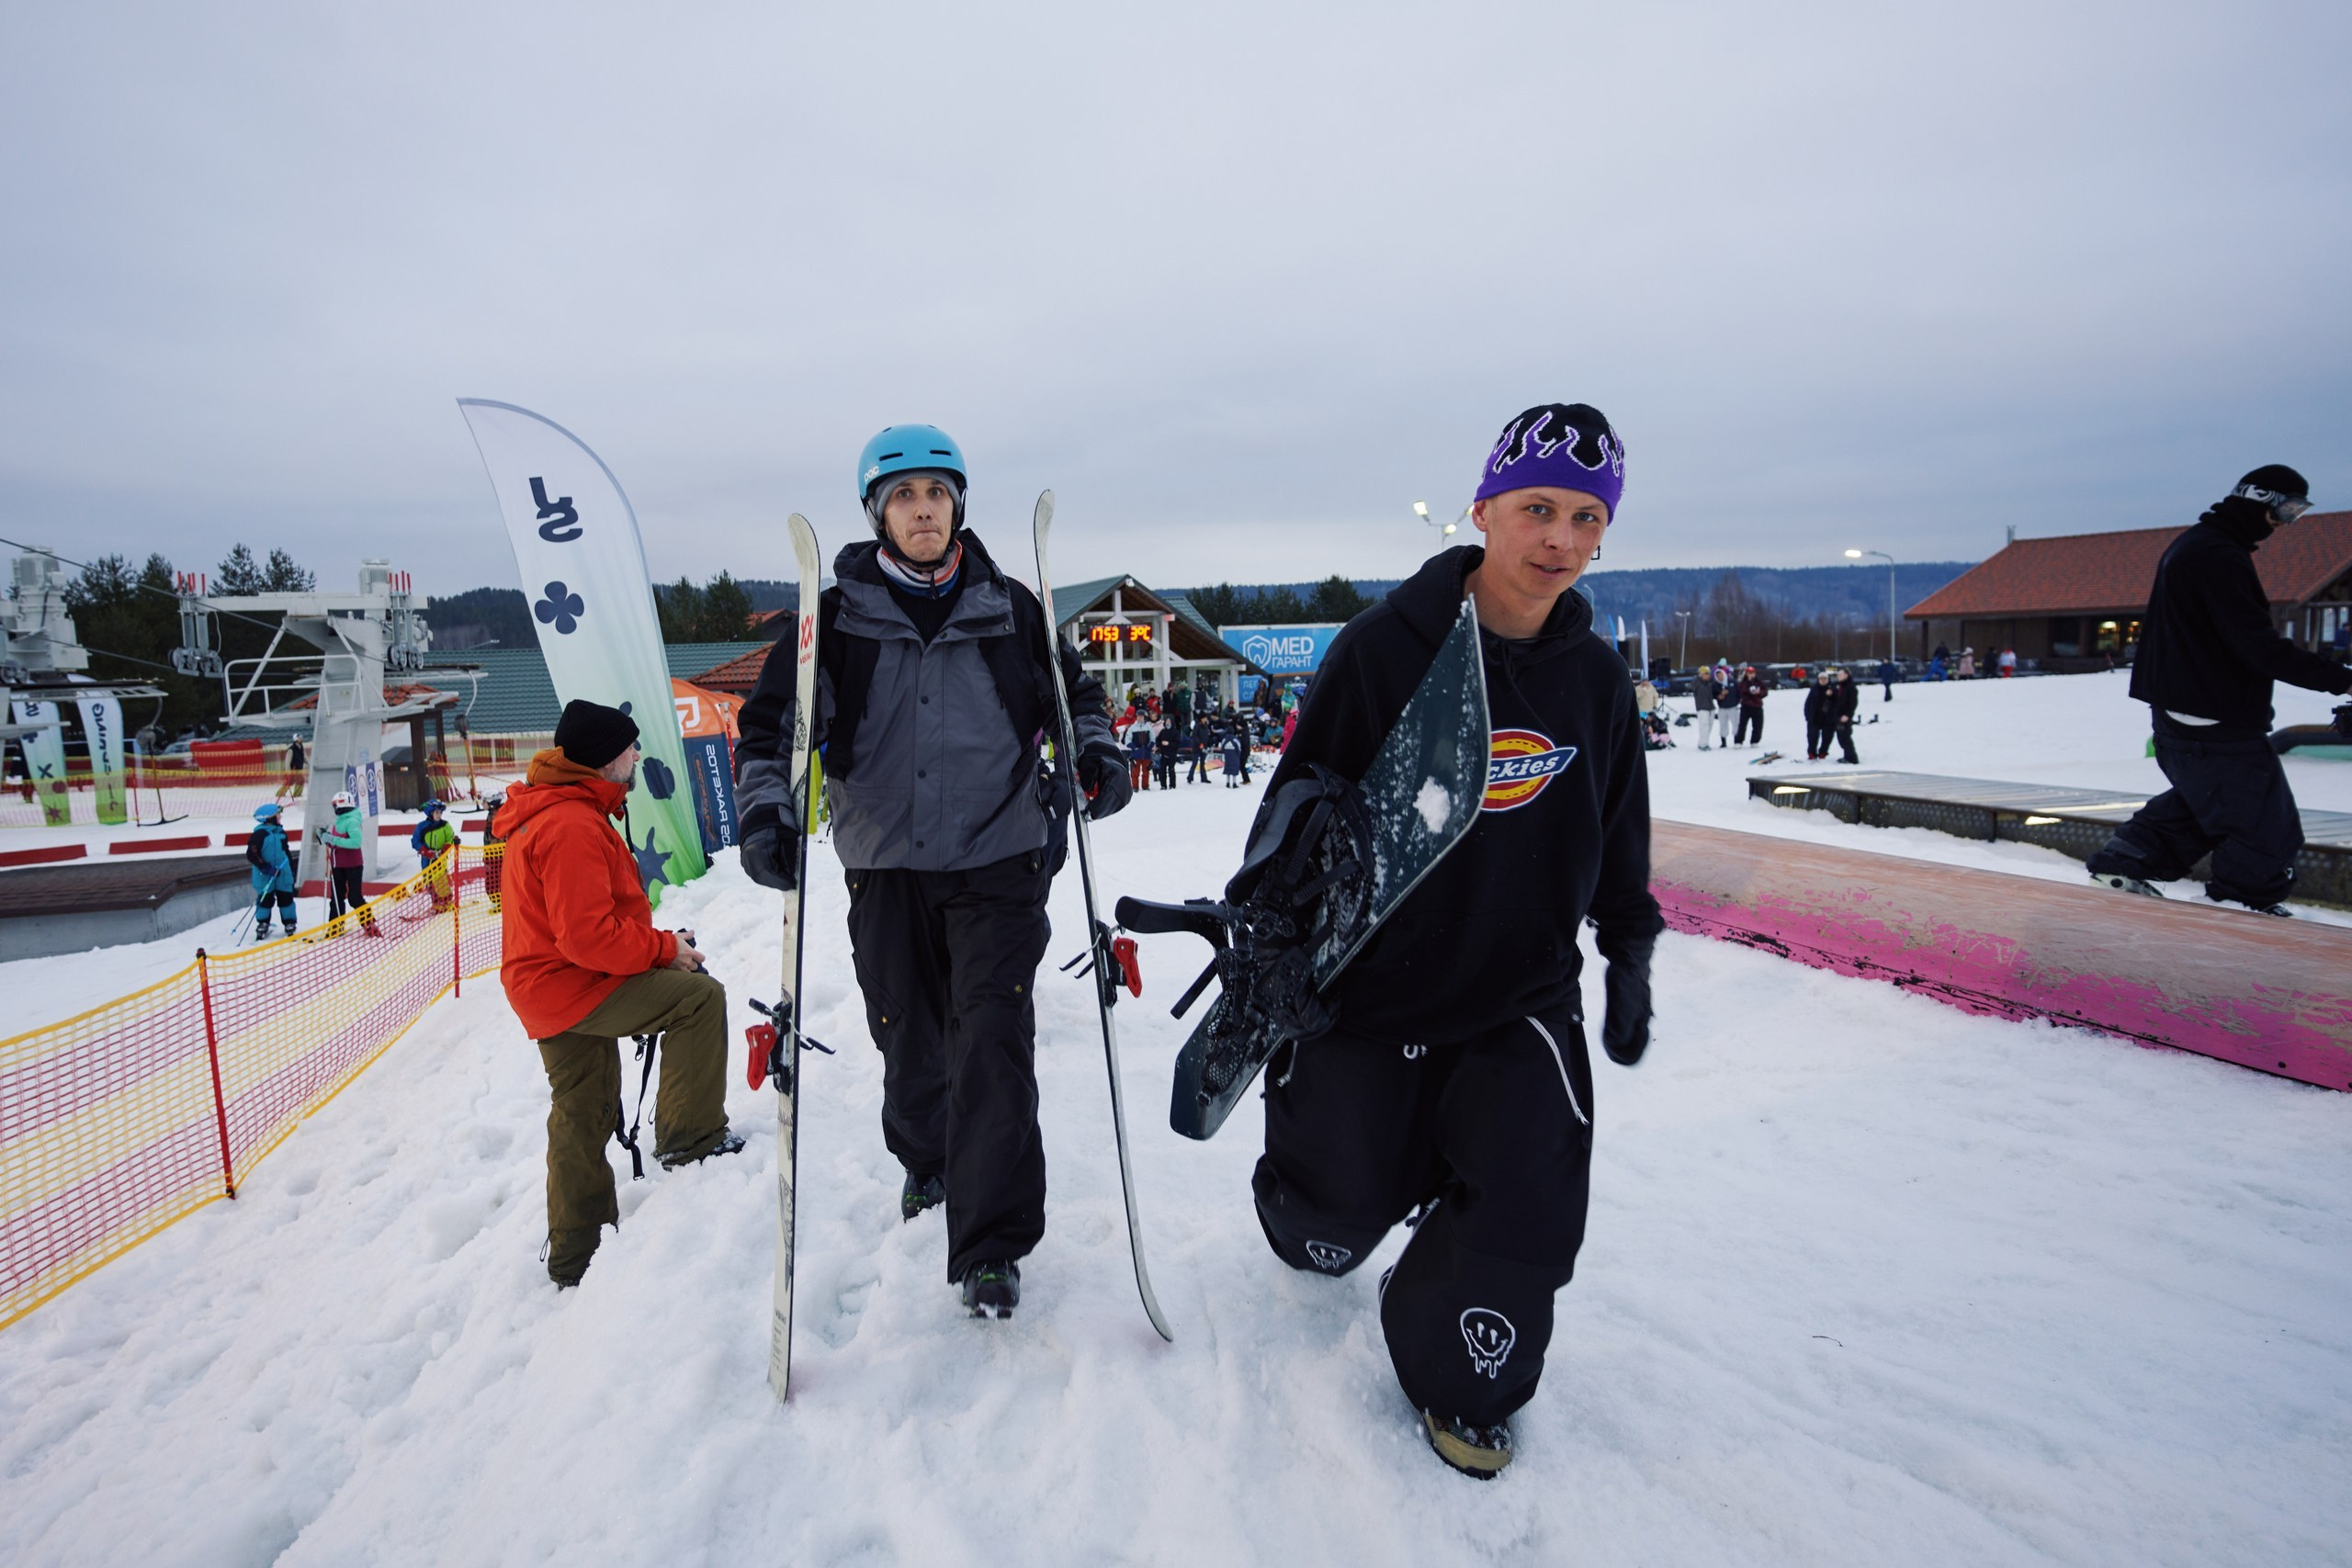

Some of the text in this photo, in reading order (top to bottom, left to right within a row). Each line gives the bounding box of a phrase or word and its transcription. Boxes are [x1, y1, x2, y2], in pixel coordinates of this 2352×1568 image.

[1272, 636, 1314, 656] MED
[1272, 655, 1313, 669] ГАРАНТ
[1488, 755, 1560, 780] ckies
